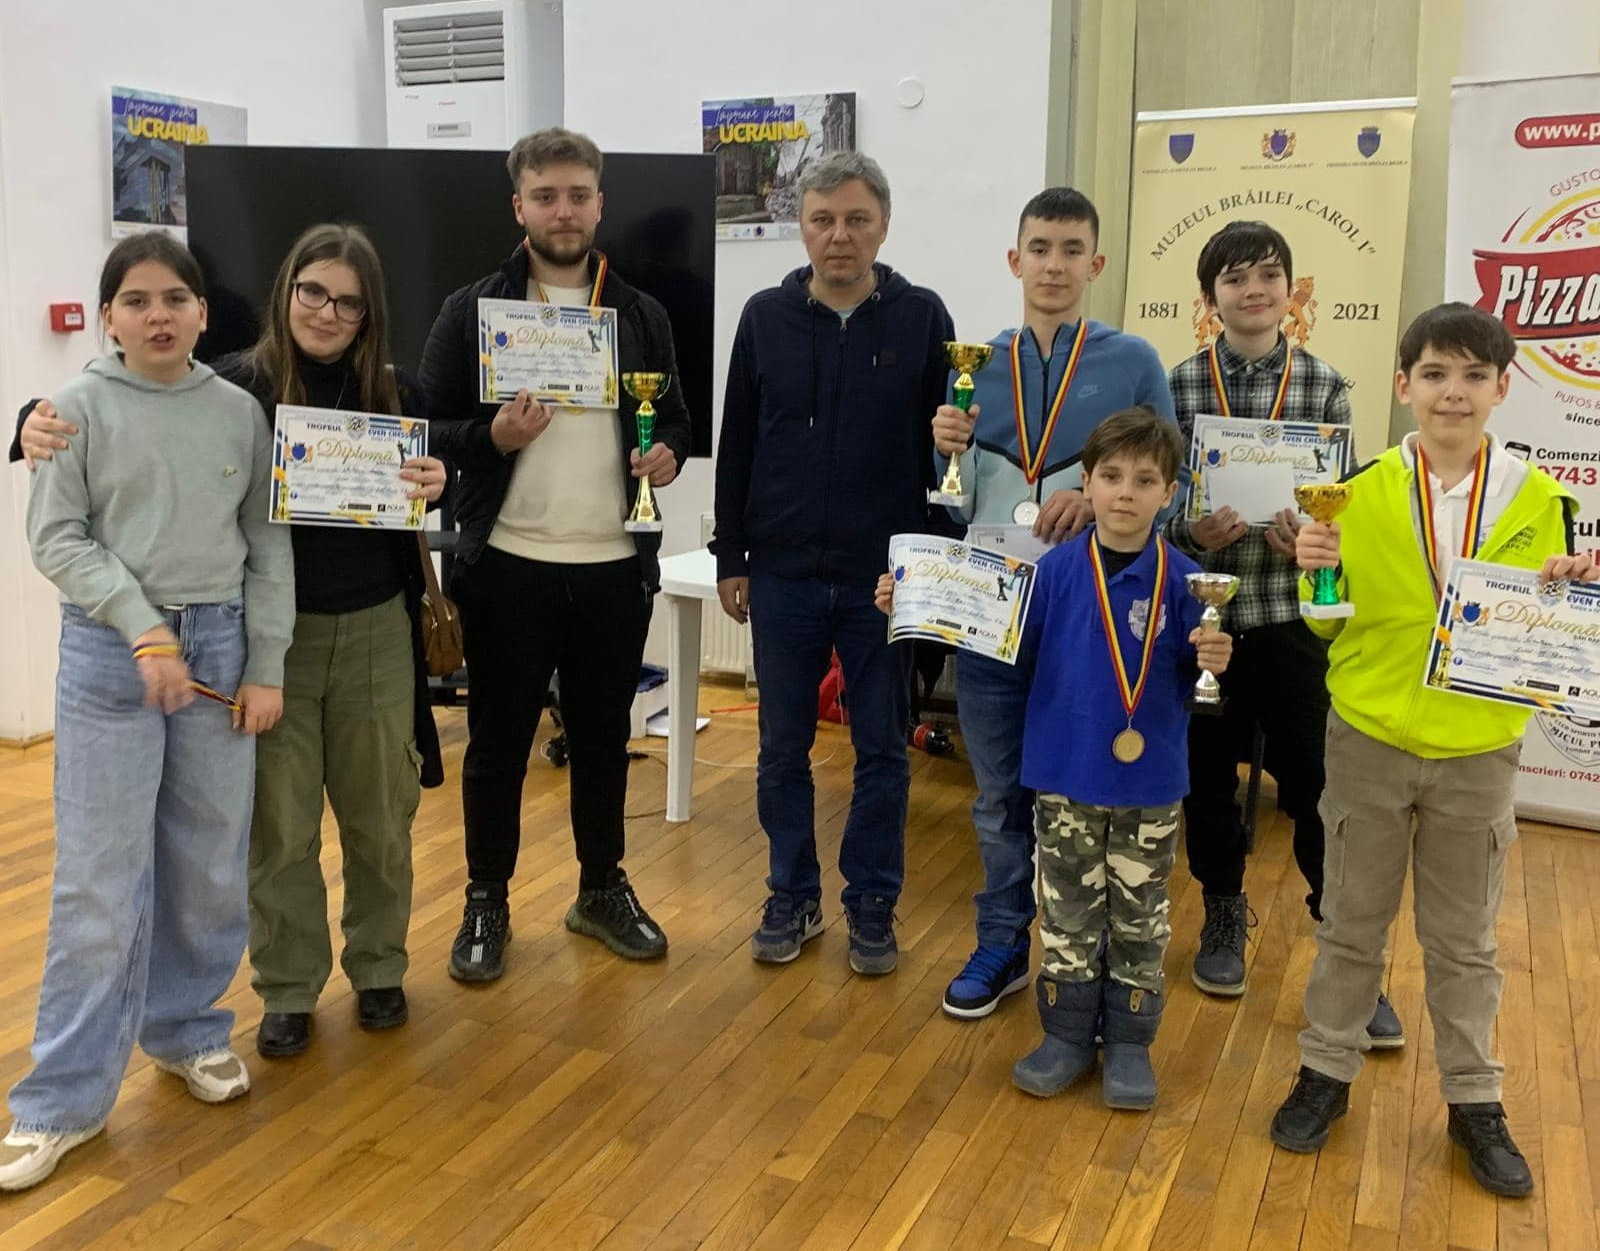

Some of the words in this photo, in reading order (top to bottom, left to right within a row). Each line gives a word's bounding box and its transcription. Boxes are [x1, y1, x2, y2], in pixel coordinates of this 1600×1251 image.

[128, 115, 209, 145] UCRAINA
[719, 119, 809, 144] UCRAINA
[1150, 204, 1217, 260] MUZEUL
[1219, 189, 1296, 213] BRĂILEI
[1138, 302, 1180, 319] 1881
[1332, 303, 1381, 320] 2021
[1485, 580, 1532, 595] TROFEUL
[1567, 594, 1593, 606] EVEN
[1519, 765, 1566, 778] nscrieri:
